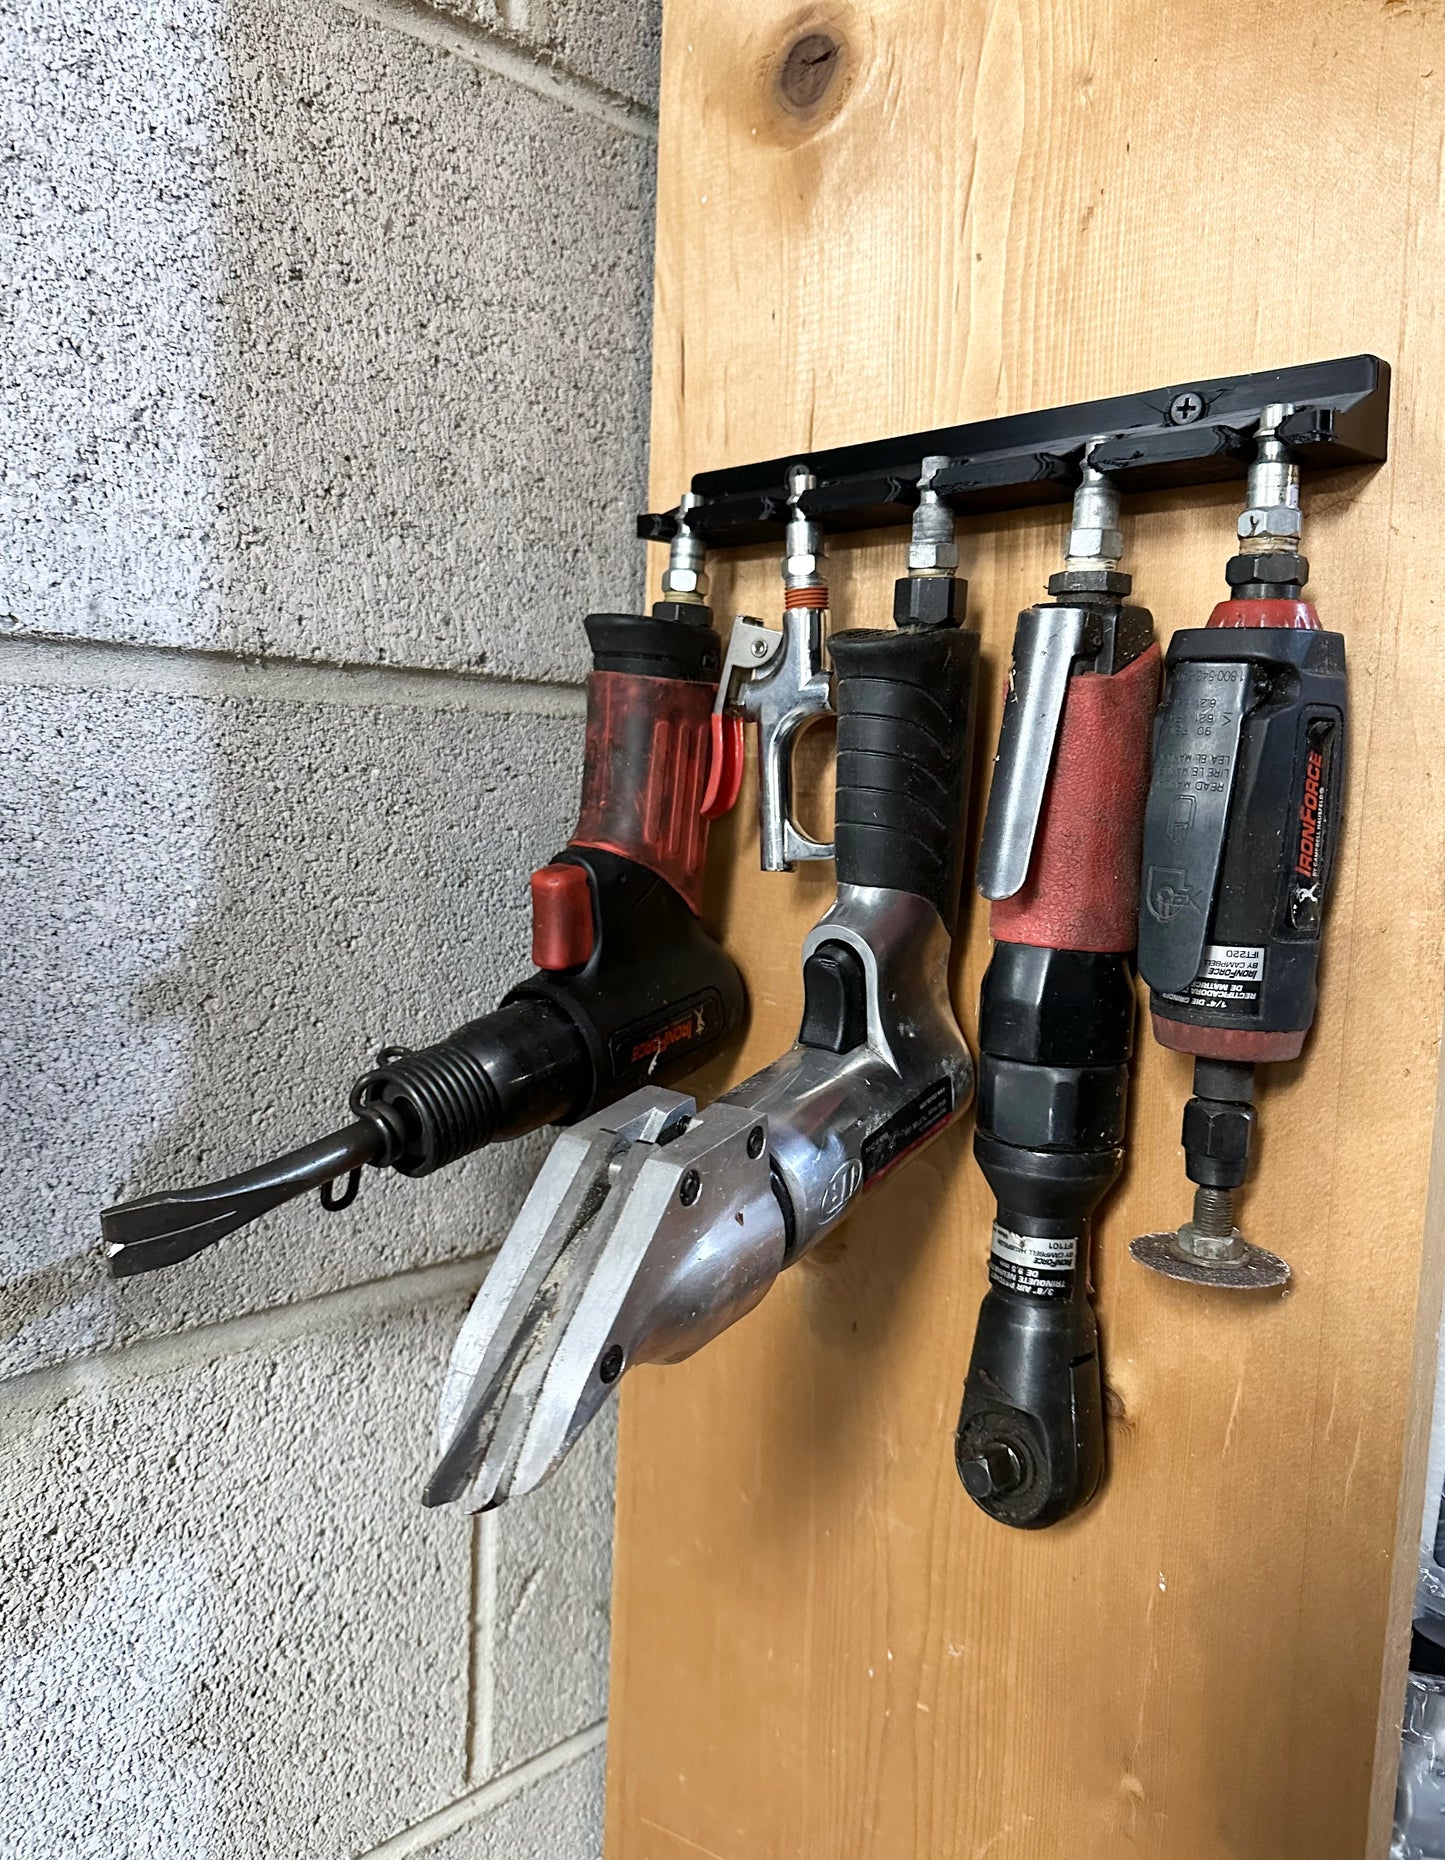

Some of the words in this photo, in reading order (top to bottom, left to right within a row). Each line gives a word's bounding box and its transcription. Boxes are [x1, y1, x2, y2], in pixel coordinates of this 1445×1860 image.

[1196, 726, 1212, 736] 90
[1196, 754, 1207, 763] EL
[1211, 755, 1230, 765] LEA
[1191, 767, 1204, 776] LE
[1207, 768, 1229, 778] LIRE
[1195, 781, 1224, 792] READ
[1312, 831, 1321, 869] CAMPBELL
[1226, 950, 1258, 959] IFT220
[1230, 984, 1242, 992] DE
[1191, 989, 1256, 1000] RECTIFICADORA
[1191, 998, 1205, 1007] DIE
[1206, 1000, 1227, 1008] 1/4"
[1028, 1249, 1063, 1258] CAMPBELL
[1026, 1269, 1038, 1278] DE
[1016, 1284, 1031, 1293] AIR
[1032, 1287, 1053, 1296] 3/8"
